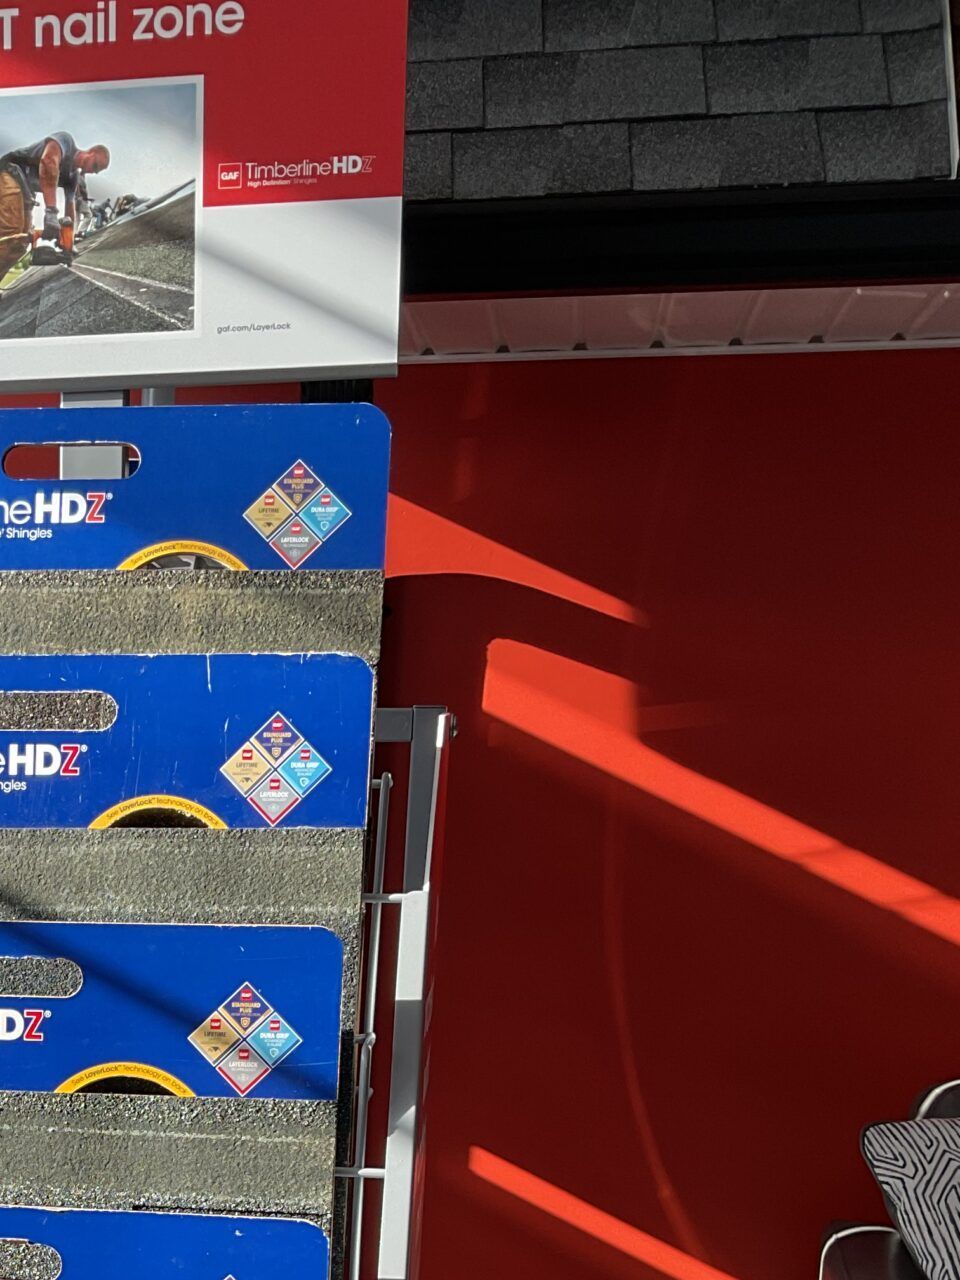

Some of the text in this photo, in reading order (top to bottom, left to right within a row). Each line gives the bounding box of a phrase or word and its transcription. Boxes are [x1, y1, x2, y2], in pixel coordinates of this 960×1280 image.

[35, 0, 116, 47] nail
[133, 0, 245, 40] zone
[221, 171, 240, 181] GAF
[6, 528, 53, 541] Shingles
